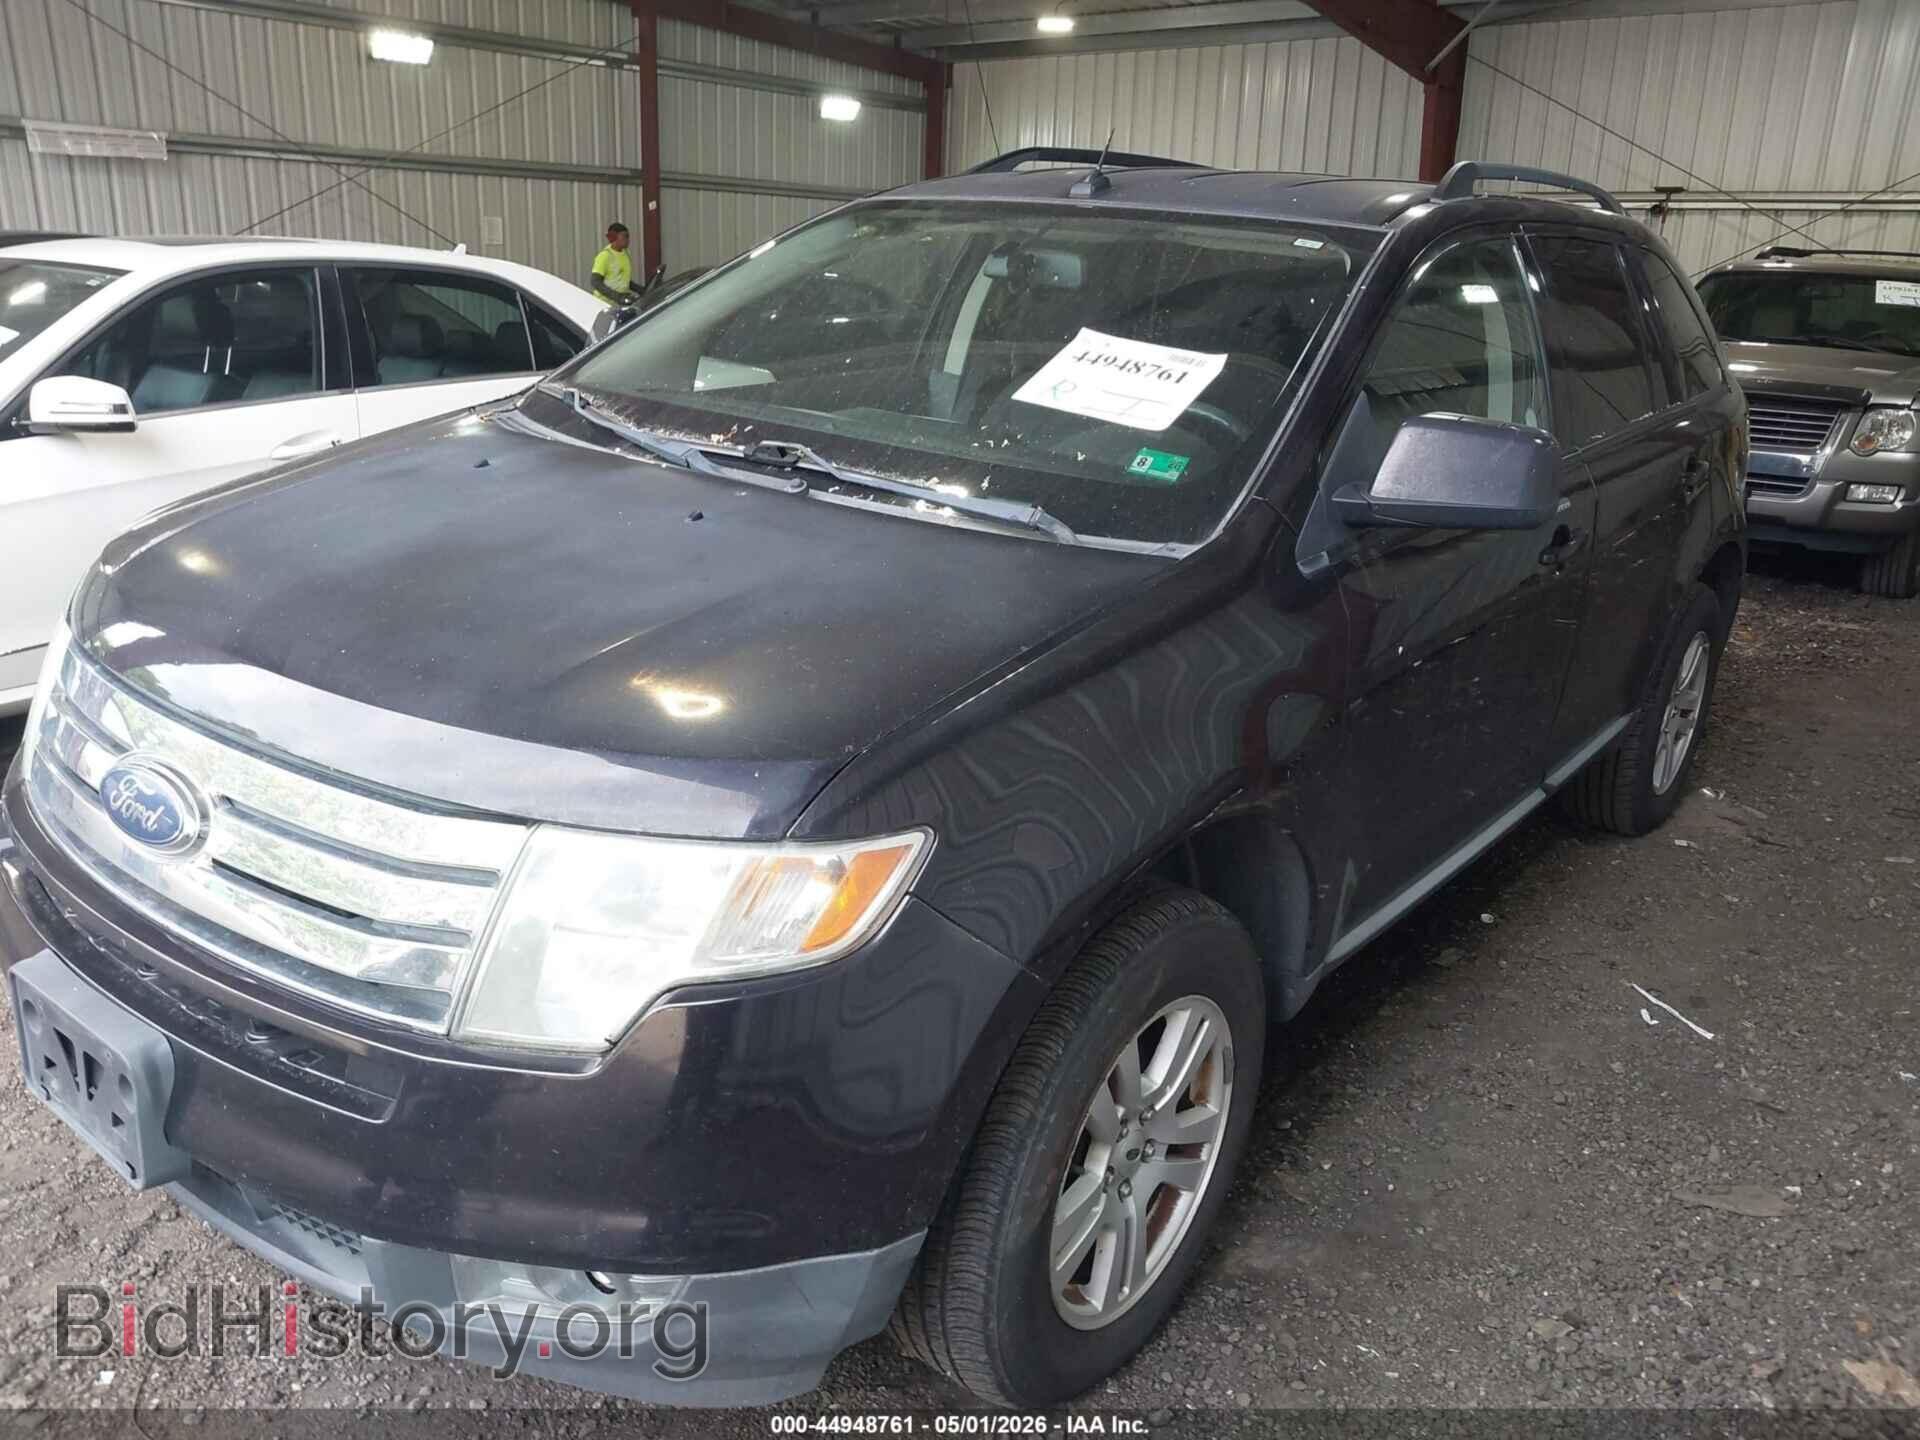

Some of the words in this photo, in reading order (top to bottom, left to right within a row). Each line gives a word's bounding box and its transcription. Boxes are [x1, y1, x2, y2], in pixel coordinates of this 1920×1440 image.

[1072, 351, 1189, 384] 44948761
[1136, 456, 1149, 468] 8
[109, 774, 167, 832] Ford
